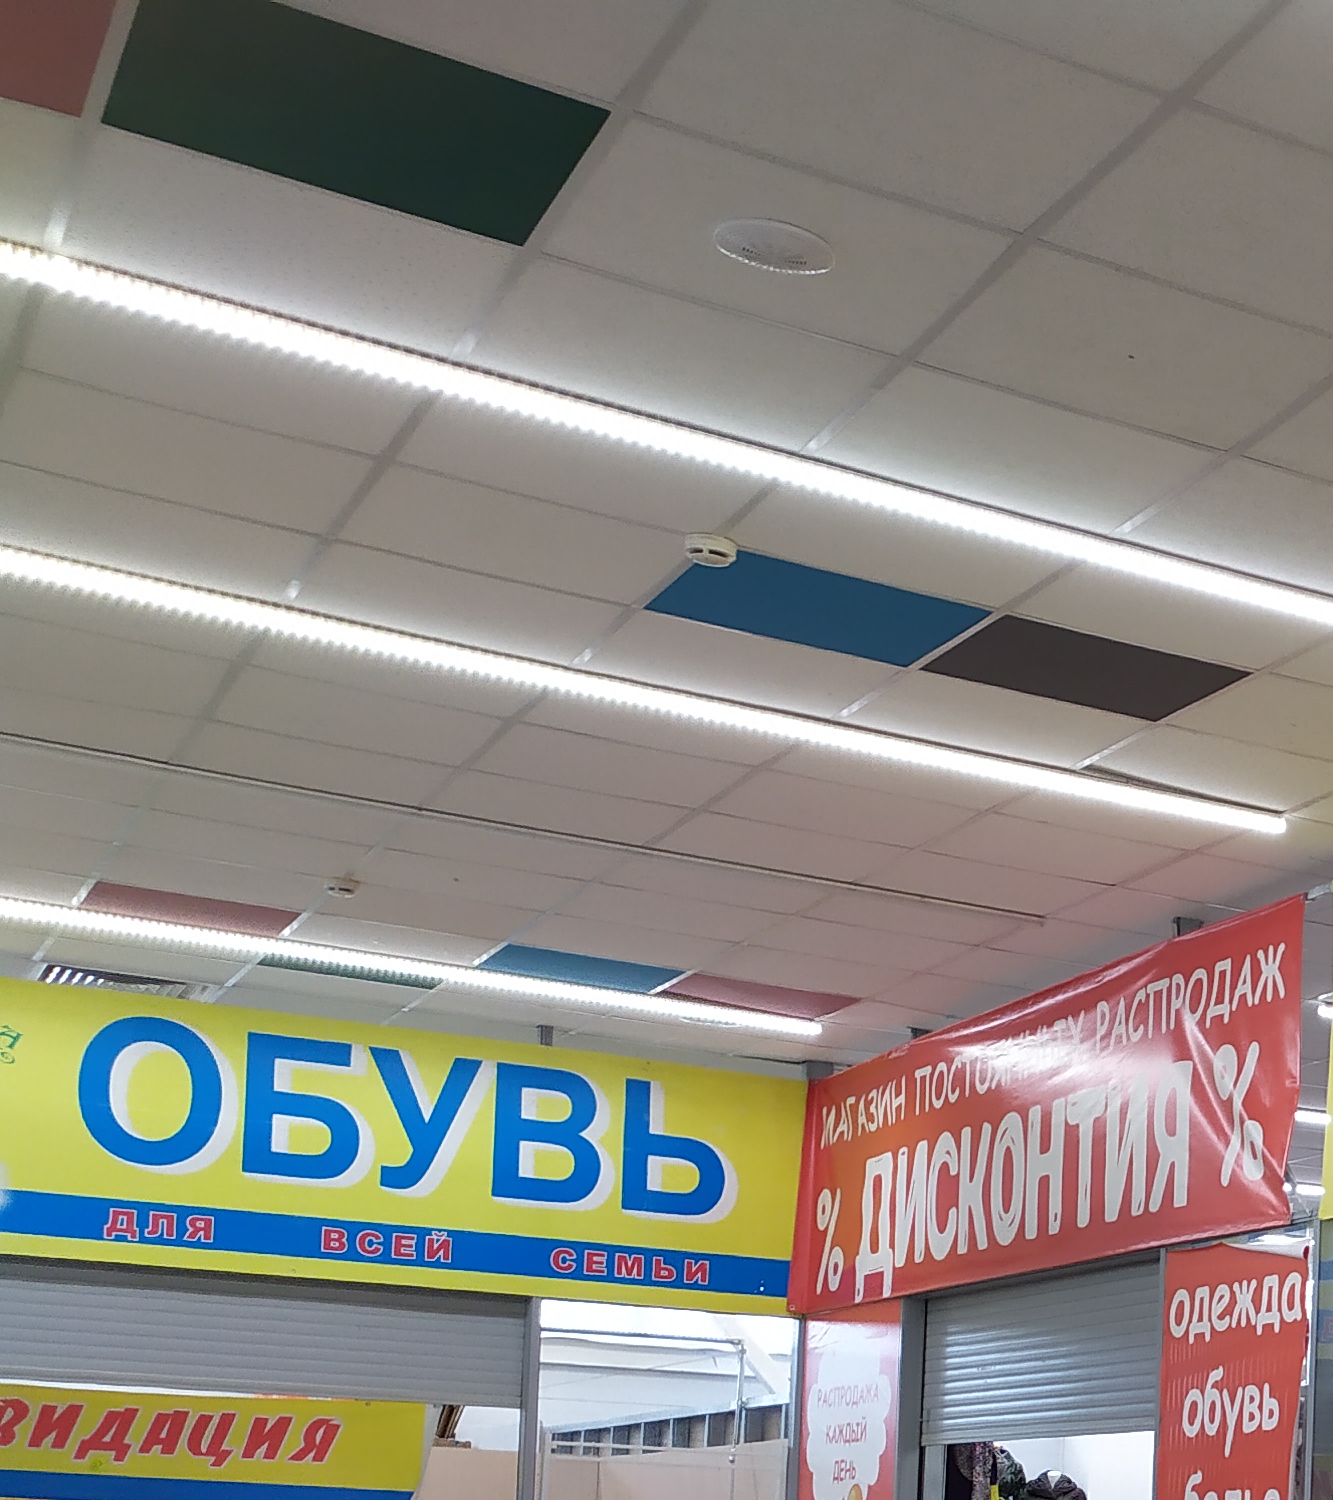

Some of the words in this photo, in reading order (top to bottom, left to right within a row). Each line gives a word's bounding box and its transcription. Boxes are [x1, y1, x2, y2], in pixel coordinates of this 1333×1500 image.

[1096, 941, 1287, 1049] РАСПРОДАЖ
[78, 1015, 734, 1219] ОБУВЬ
[854, 1061, 1193, 1303] ДИСКОНТИЯ
[103, 1207, 216, 1244] ДЛЯ
[320, 1226, 454, 1264] ВСЕЙ
[550, 1248, 711, 1286] СЕМЬИ
[1170, 1271, 1303, 1341] одежда
[817, 1383, 879, 1409] РАСПРОДАЖА
[826, 1415, 867, 1446] КАЖДЫЙ
[1182, 1365, 1279, 1457] обувь
[832, 1459, 857, 1485] ДЕНЬ
